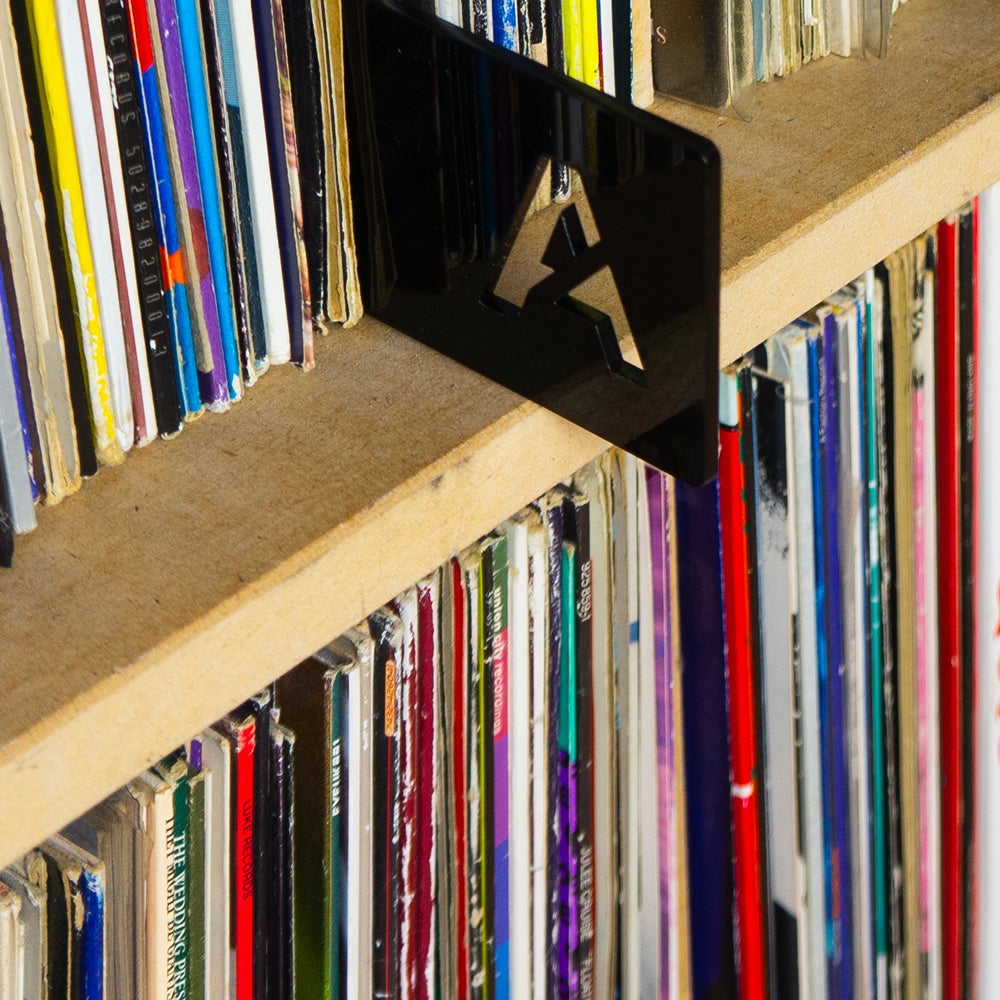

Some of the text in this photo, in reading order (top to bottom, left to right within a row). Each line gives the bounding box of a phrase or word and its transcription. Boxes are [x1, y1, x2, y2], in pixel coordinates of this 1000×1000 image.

[479, 155, 649, 388] A
[493, 586, 503, 631] union
[493, 633, 505, 664] city
[173, 830, 186, 868] THE
[243, 799, 254, 901] LUKE RECORDS
[173, 869, 186, 955] WEDDING
